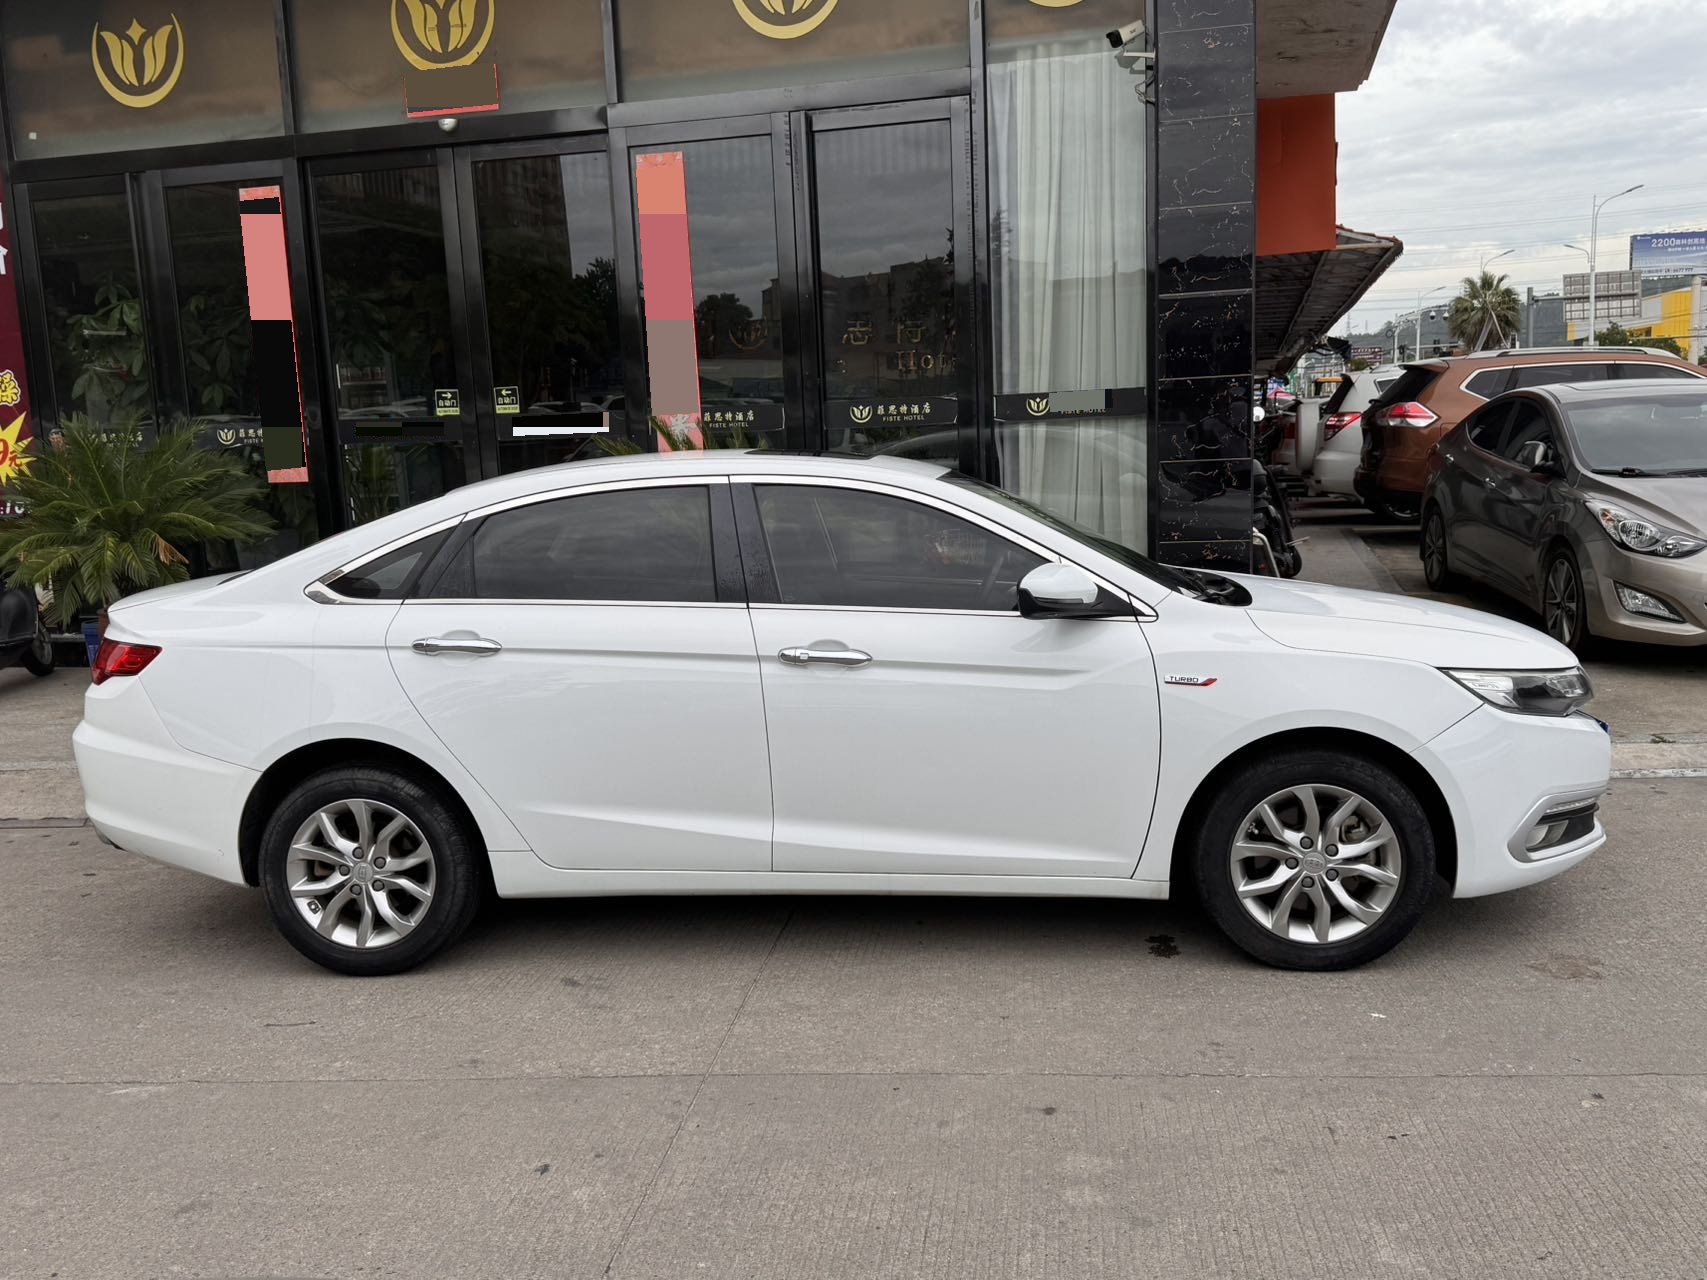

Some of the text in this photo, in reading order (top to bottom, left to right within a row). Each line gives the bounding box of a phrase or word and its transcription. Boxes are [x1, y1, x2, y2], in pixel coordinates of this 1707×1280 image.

[903, 412, 925, 421] HOTEL
[729, 420, 750, 428] HOTEL
[1170, 675, 1199, 683] TURBO
